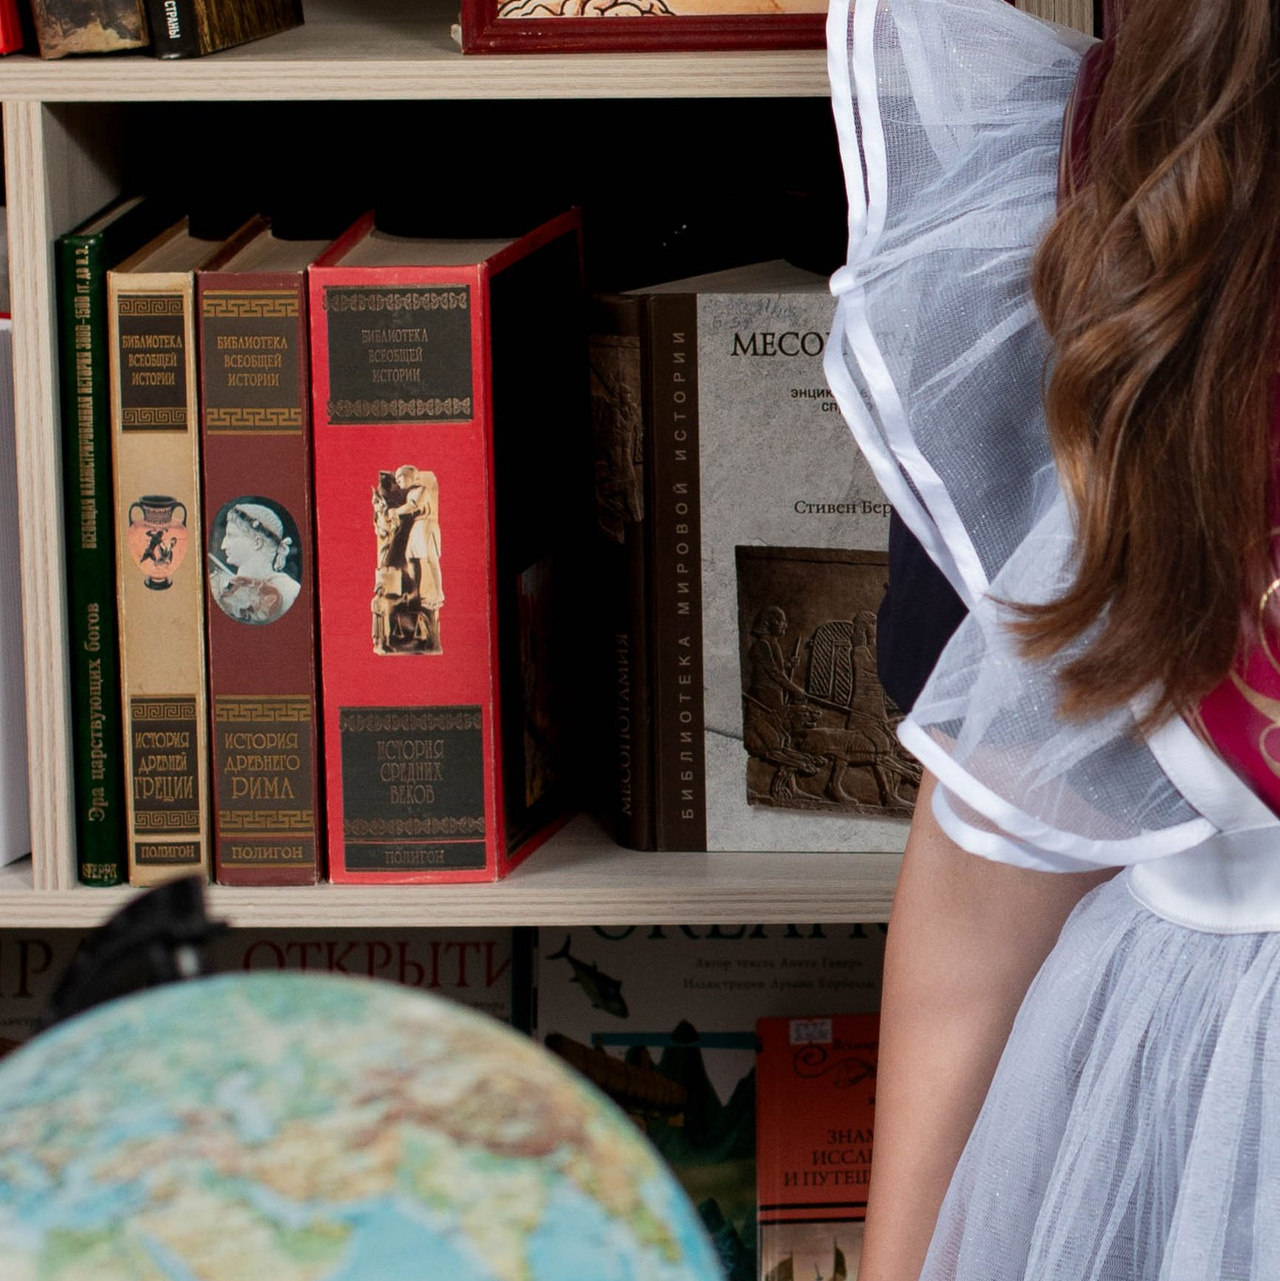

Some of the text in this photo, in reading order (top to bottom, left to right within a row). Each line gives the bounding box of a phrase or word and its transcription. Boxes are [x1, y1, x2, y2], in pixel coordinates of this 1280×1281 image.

[163, 0, 181, 40] СТРАНЫ
[121, 335, 183, 349] БИБЛИОТЕКА
[217, 335, 288, 350] БИБЛИОТЕКА
[361, 328, 429, 344] БИБЛИОТЕКА
[128, 352, 177, 368] ВСЕОБЩЕЙ
[224, 353, 282, 368] ВСЕОБЩЕЙ
[368, 348, 423, 364] ВСЕОБЩЕЙ
[76, 350, 93, 394] ИСТОРИЯ
[131, 372, 176, 386] ИСТОРИИ
[228, 372, 279, 387] ИСТОРИИ
[372, 368, 421, 383] ИСТОРИИ
[794, 500, 856, 514] Стивен
[673, 331, 695, 819] БИБЛИОТЕКА МИРОВОЙ ИСТОРИИ
[84, 602, 105, 821] Эра царствующих богов
[617, 633, 633, 817] МЕСОПОТАМИЯ
[134, 732, 190, 748] ИСТОРИЯ
[224, 733, 299, 749] ИСТОРИЯ
[377, 740, 445, 761] ИСТОРИЯ
[138, 752, 188, 774] ДРЕВНЕЙ
[225, 755, 300, 773] ДРЕВНЕГО
[380, 762, 444, 783] СРЕДНИХ
[134, 776, 193, 802] ГРЕЦИИ
[231, 777, 295, 799] РИМА
[390, 785, 435, 805] ВЕКОВ
[141, 845, 194, 859] ПОЛИГОН
[232, 846, 303, 860] ПОЛИГОН
[385, 850, 445, 865] ПОЛИГОН
